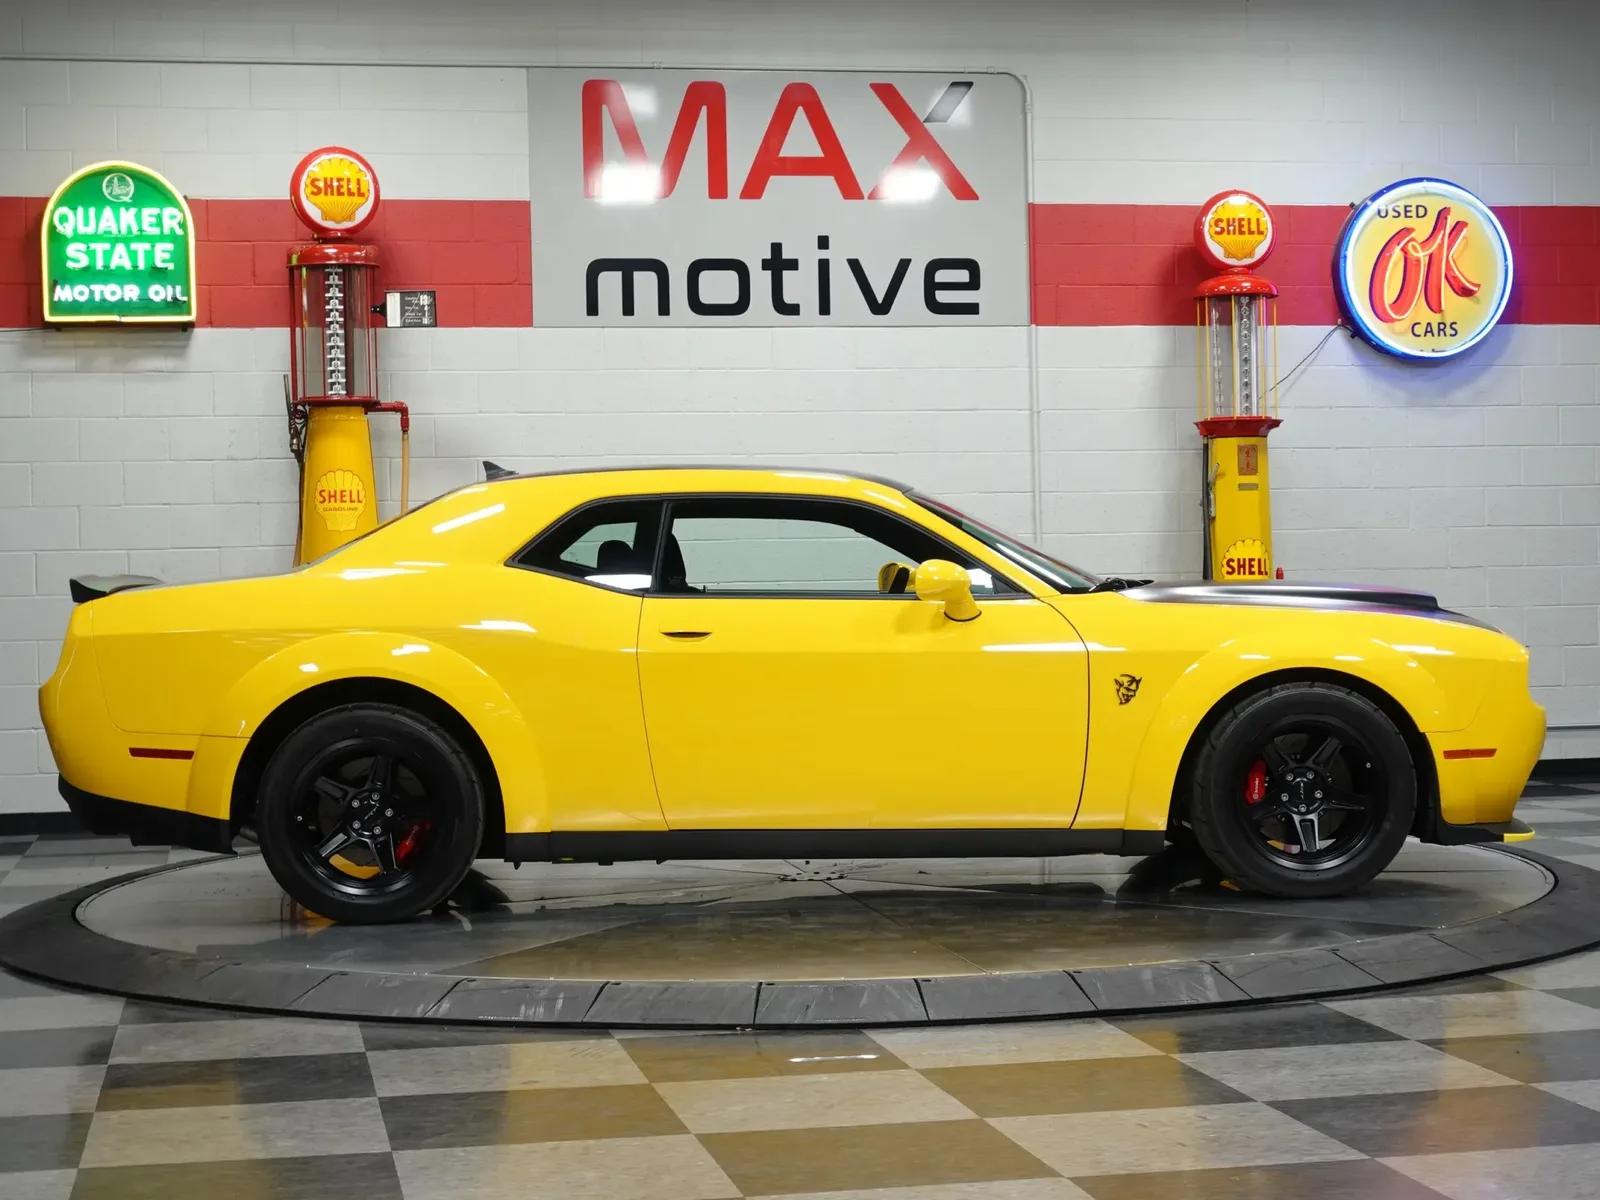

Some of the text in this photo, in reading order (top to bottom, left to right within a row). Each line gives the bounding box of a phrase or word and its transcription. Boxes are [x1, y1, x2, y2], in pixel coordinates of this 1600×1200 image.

[582, 79, 979, 200] MAX
[309, 177, 365, 197] SHELL
[1377, 205, 1428, 218] USED
[53, 206, 184, 239] QUAKER
[1214, 217, 1265, 236] SHELL
[65, 242, 175, 270] STATE
[1369, 206, 1481, 323] OK
[586, 235, 981, 316] motive
[54, 283, 188, 302] MOTOR OIL
[1411, 322, 1459, 337] CARS
[319, 489, 363, 504] SHELL
[1225, 558, 1268, 576] SHELL
